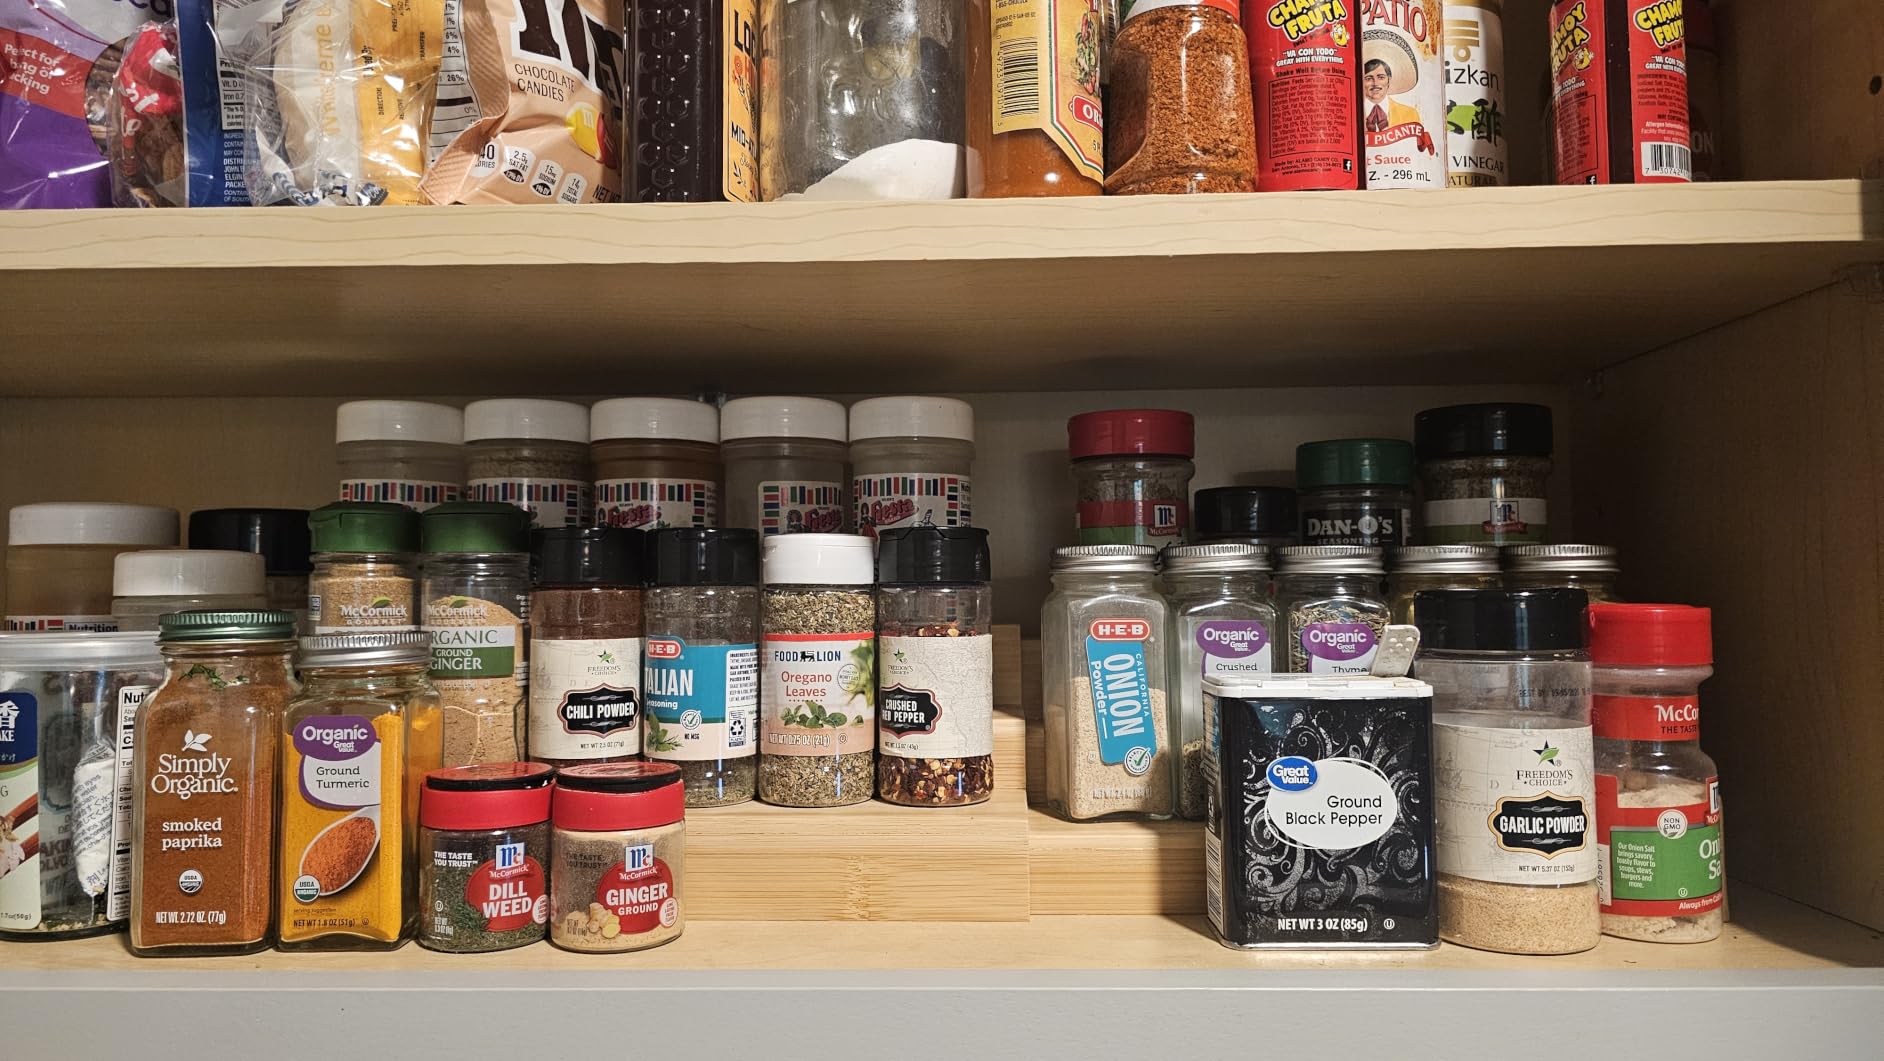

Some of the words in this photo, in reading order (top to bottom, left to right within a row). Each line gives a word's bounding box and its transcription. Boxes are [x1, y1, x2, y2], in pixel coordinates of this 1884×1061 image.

[1285, 0, 1346, 39] FRUTA
[1298, 48, 1313, 56] CON
[1276, 59, 1295, 67] GREAT
[1312, 55, 1344, 64] EVERYTHING
[514, 63, 575, 93] CHOCOLATE
[1276, 70, 1294, 78] Shake
[1332, 67, 1346, 76] Using
[1444, 60, 1500, 92] izkan
[517, 78, 564, 102] CANDIES
[1374, 124, 1423, 145] PICANTE
[1375, 154, 1411, 165] Sauce
[1453, 155, 1504, 172] VINEGAR
[1392, 169, 1413, 180] 296
[1416, 171, 1431, 182] mL
[593, 184, 609, 199] NET
[871, 498, 914, 524] Fiesta
[1307, 517, 1394, 537] DAN-O'S
[1317, 537, 1380, 546] SEASONING
[340, 605, 408, 617] McCormick
[1203, 626, 1260, 647] Organic
[1309, 628, 1367, 648] Organic
[1229, 641, 1248, 649] Great
[1336, 643, 1356, 651] Great
[435, 649, 473, 657] GROUND
[774, 650, 798, 662] FOOD
[817, 650, 841, 662] LION
[430, 657, 482, 670] GINGER
[1216, 663, 1258, 671] Crushed
[1331, 665, 1367, 673] Thyme
[781, 671, 832, 685] Oregano
[786, 685, 826, 697] Leaves
[1090, 660, 1107, 717] Powder
[1135, 653, 1150, 717] CALIFORNIA
[1103, 653, 1145, 737] ONION
[566, 705, 593, 719] CHILI
[596, 702, 635, 719] POWDER
[885, 699, 917, 712] CRUSHED
[893, 711, 925, 724] PEPPER
[302, 724, 369, 745] Organic
[1662, 726, 1678, 734] THE
[333, 740, 354, 749] Great
[769, 733, 778, 744] NET
[778, 734, 787, 744] WT
[788, 734, 801, 745] 0.75
[802, 735, 811, 745] OZ
[158, 752, 232, 779] Simply
[316, 765, 360, 776] Ground
[1272, 764, 1310, 778] Great
[1282, 774, 1310, 785] Value
[1516, 769, 1573, 780] FREEDOM'S
[316, 778, 370, 789] Turmeric
[1327, 795, 1382, 808] Ground
[162, 817, 222, 832] smoked
[1286, 812, 1325, 825] Black
[1331, 812, 1383, 828] Pepper
[1500, 816, 1544, 834] GARLIC
[1546, 815, 1585, 834] POWDER
[161, 834, 223, 851] paprika
[434, 850, 446, 859] THE
[448, 852, 473, 860] TASTE
[1618, 850, 1634, 858] brings
[434, 858, 447, 867] YOU
[489, 864, 530, 879] McCormick
[618, 866, 659, 881] McCormick
[1621, 872, 1641, 880] burgers
[489, 880, 528, 900] DILL
[606, 882, 668, 906] GINGER
[482, 896, 533, 919] WEED
[618, 902, 659, 916] GROUND
[1679, 900, 1701, 910] Always
[1702, 898, 1713, 906] from
[156, 911, 167, 924] NET
[180, 911, 195, 924] 2.72
[208, 910, 226, 925] (77g)
[293, 919, 305, 927] NET
[306, 919, 316, 927] WT
[1277, 918, 1299, 930] NET
[1299, 918, 1315, 930] WT
[1317, 918, 1324, 930] 3
[1325, 918, 1339, 930] OZ
[1340, 917, 1368, 932] (85g)
